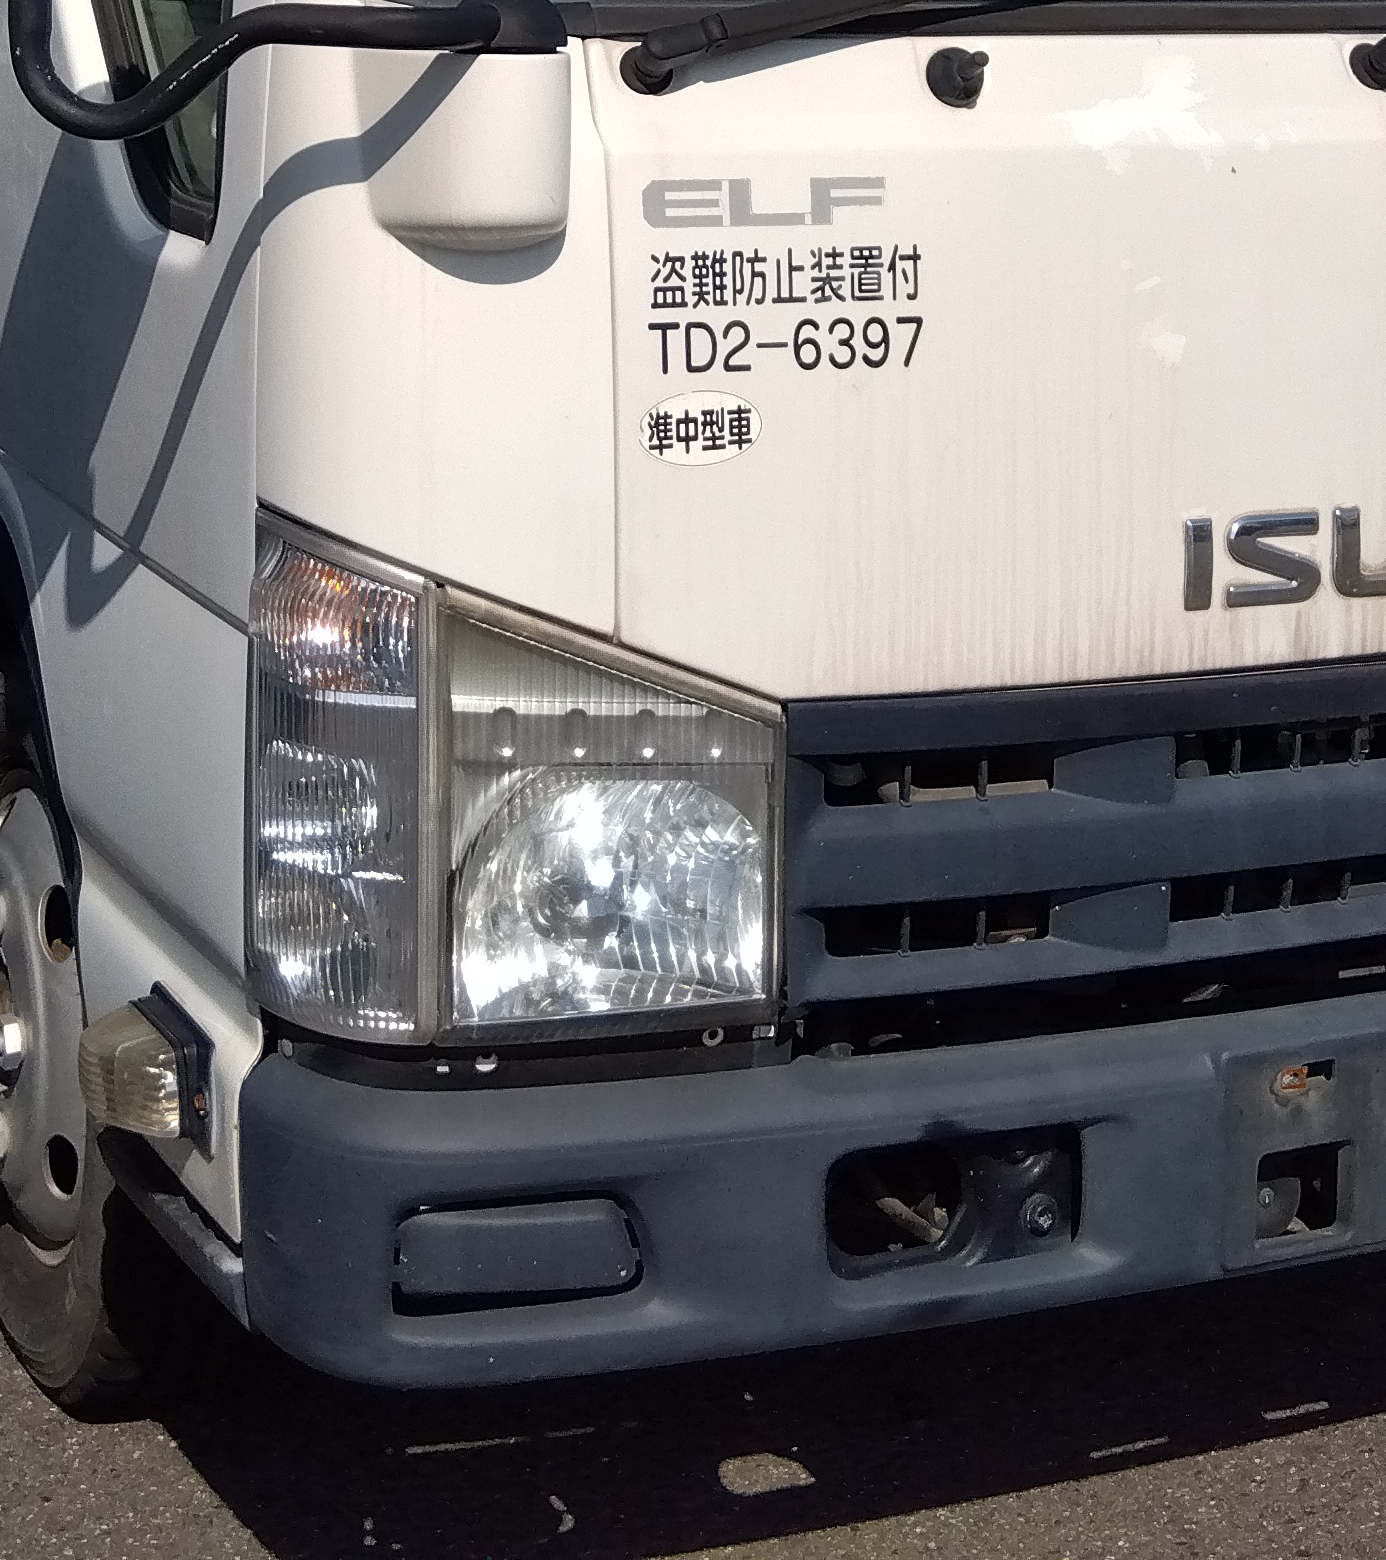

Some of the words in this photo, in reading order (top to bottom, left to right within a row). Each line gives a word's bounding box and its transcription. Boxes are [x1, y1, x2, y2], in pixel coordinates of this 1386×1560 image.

[642, 176, 886, 228] ELF
[650, 244, 921, 309] 盗難防止装置付
[647, 316, 923, 375] TD2-6397
[647, 405, 753, 456] 準中型車
